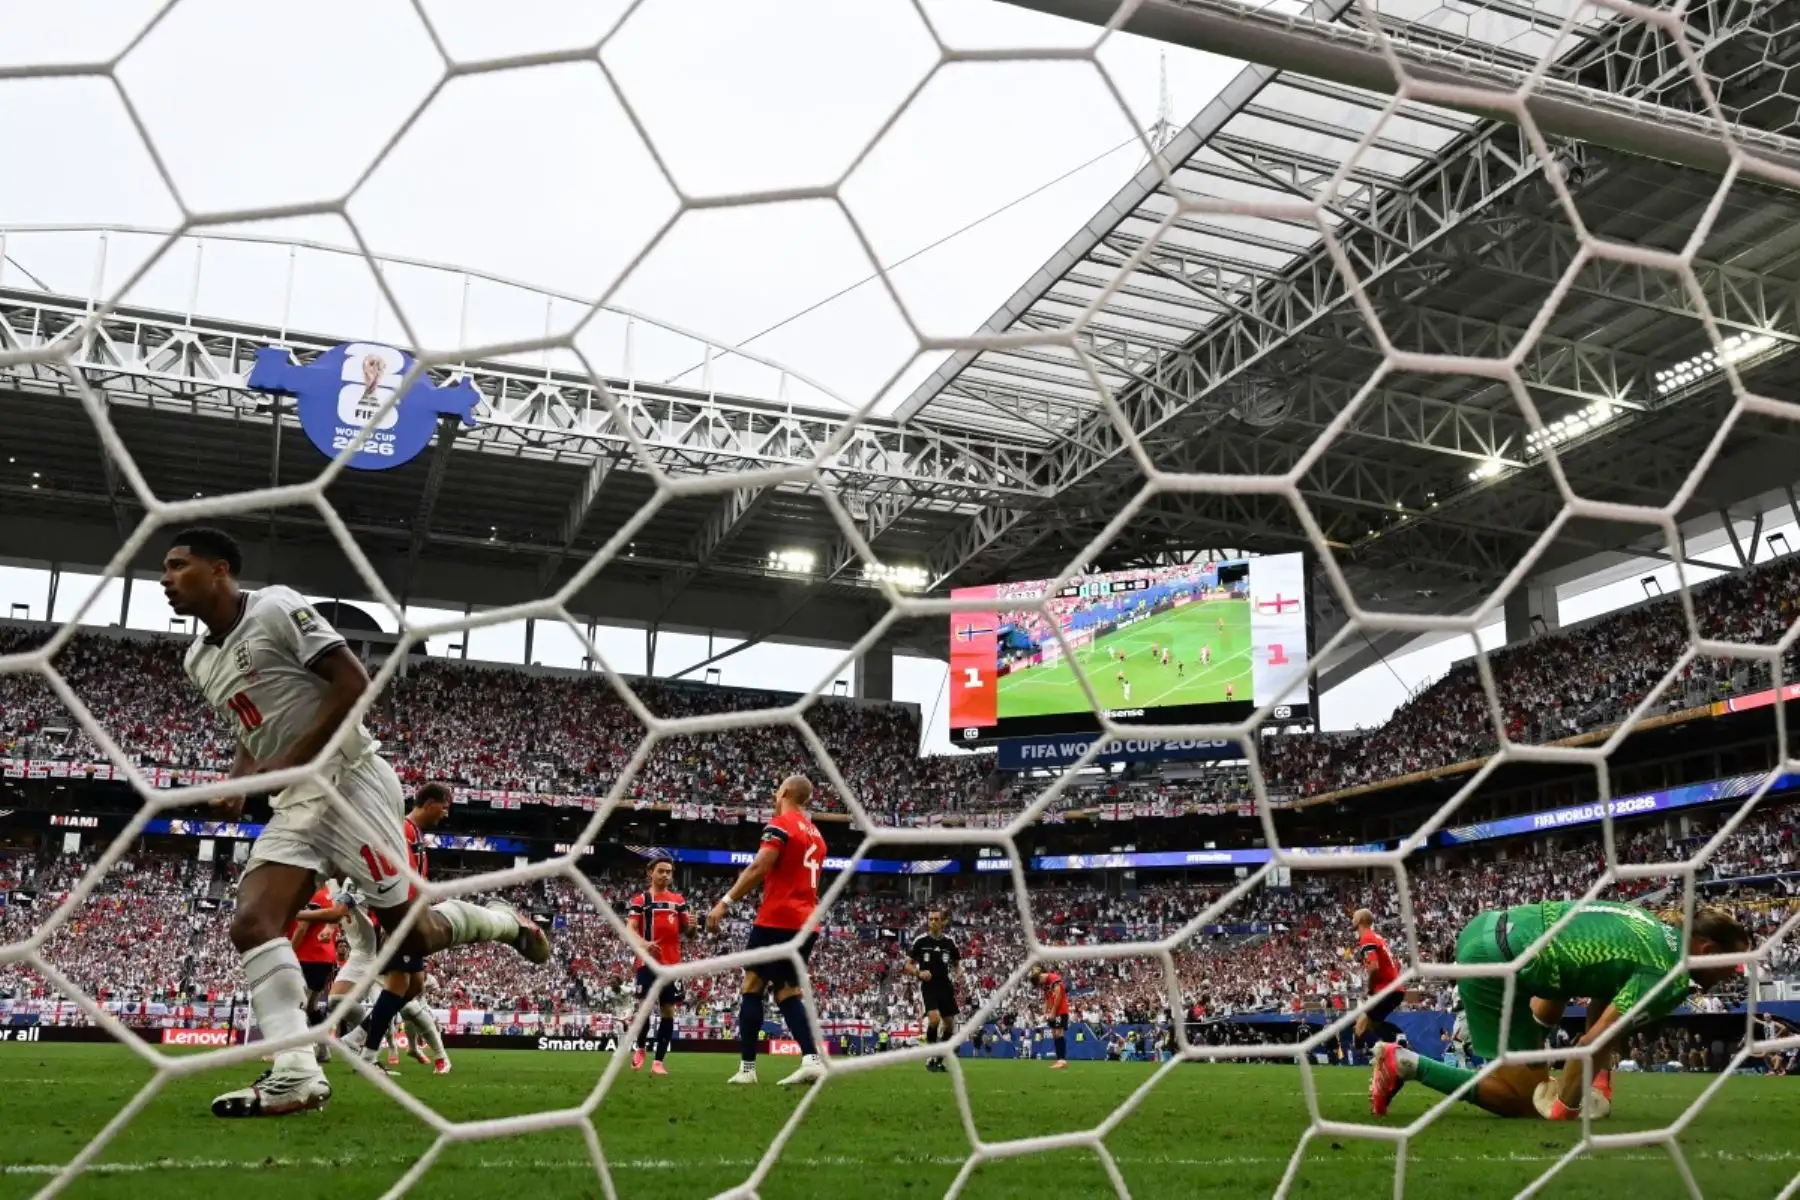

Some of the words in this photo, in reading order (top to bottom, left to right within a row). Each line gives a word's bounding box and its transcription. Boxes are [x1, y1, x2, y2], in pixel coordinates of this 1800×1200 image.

[375, 432, 396, 441] CUP
[1267, 643, 1289, 665] 1
[964, 667, 984, 688] 1
[227, 692, 263, 732] 10
[1021, 745, 1057, 759] FIFA
[1126, 737, 1161, 753] CUP
[50, 815, 98, 827] MIAMI
[1535, 813, 1556, 828] FIFA
[1556, 807, 1593, 823] WORLD
[1593, 803, 1615, 817] CP
[1617, 796, 1657, 813] 2026
[731, 853, 755, 864] FIFA
[803, 843, 820, 888] 4
[16, 1026, 40, 1042] all
[538, 1037, 600, 1050] Smarter
